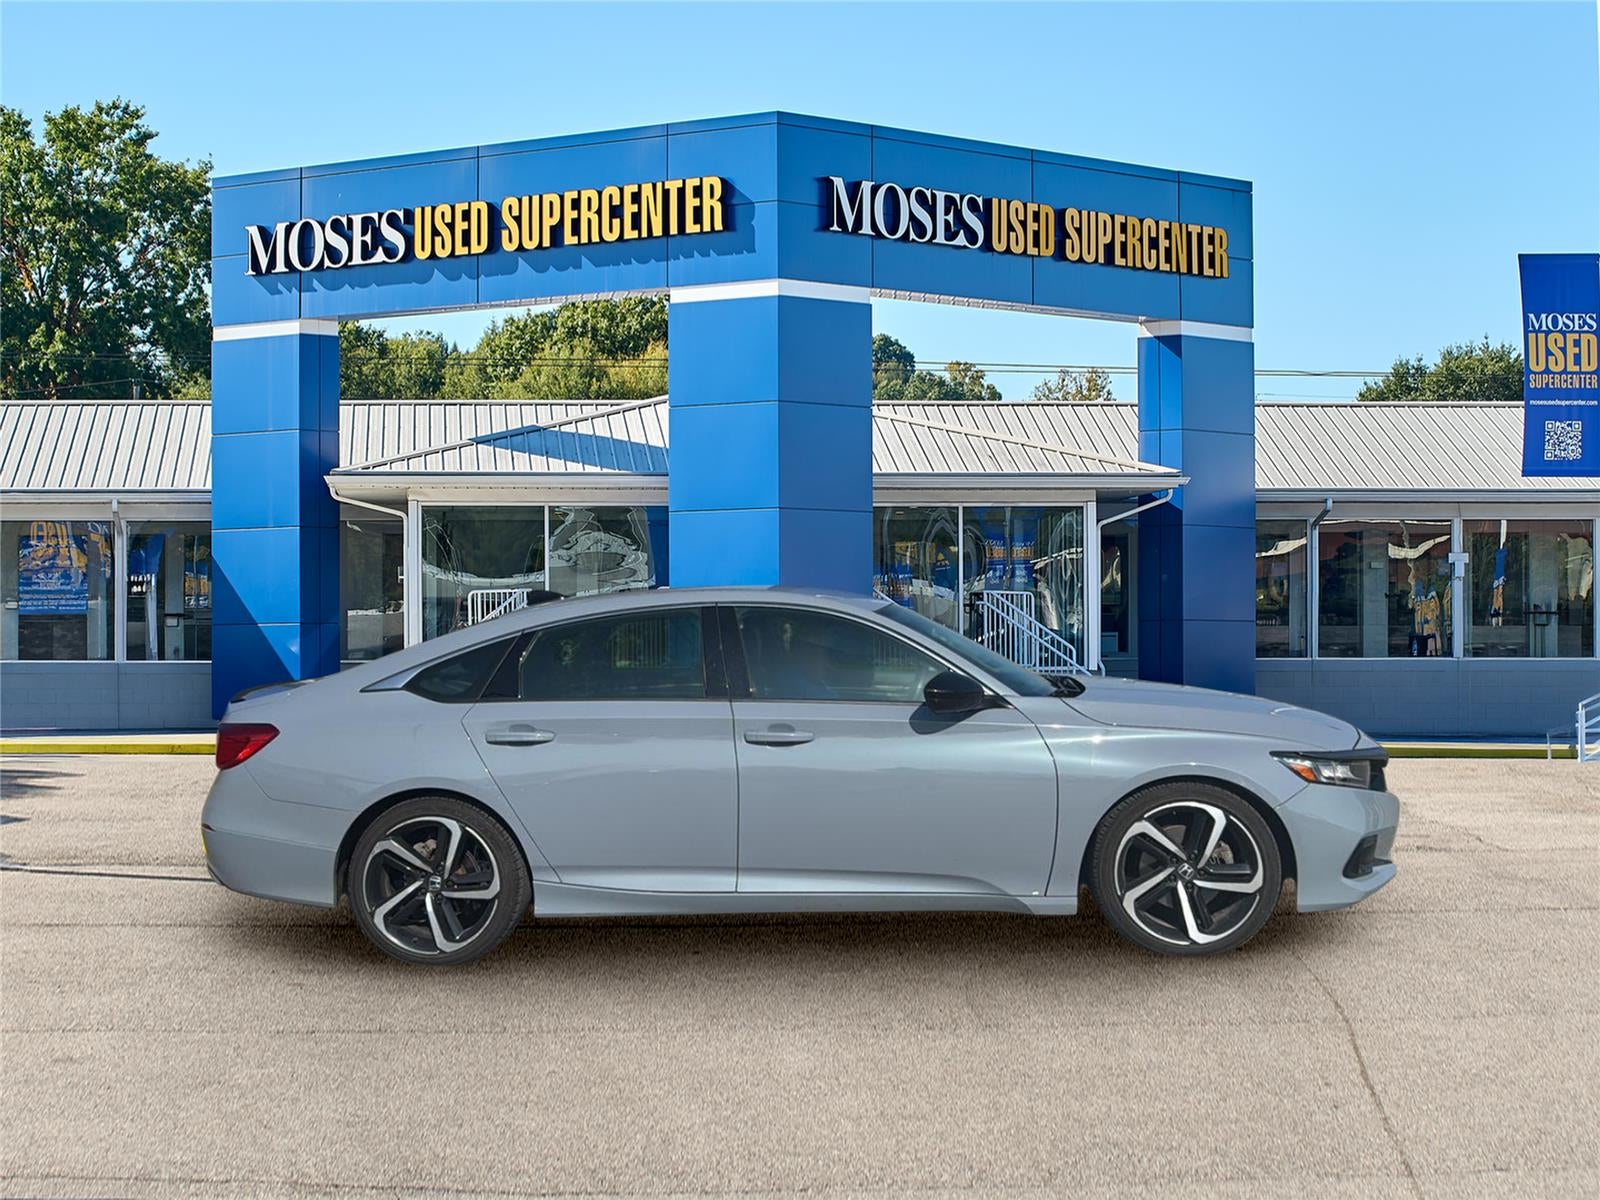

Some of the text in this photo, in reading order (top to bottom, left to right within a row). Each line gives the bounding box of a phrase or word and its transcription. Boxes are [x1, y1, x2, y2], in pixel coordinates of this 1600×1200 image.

[245, 175, 724, 277] MOSES USED SUPERCENTER
[829, 176, 1230, 279] MOSES USED SUPERCENTER
[1528, 313, 1597, 332] MOSES
[1528, 333, 1598, 372] USED
[1529, 374, 1598, 389] SUPERCENTER
